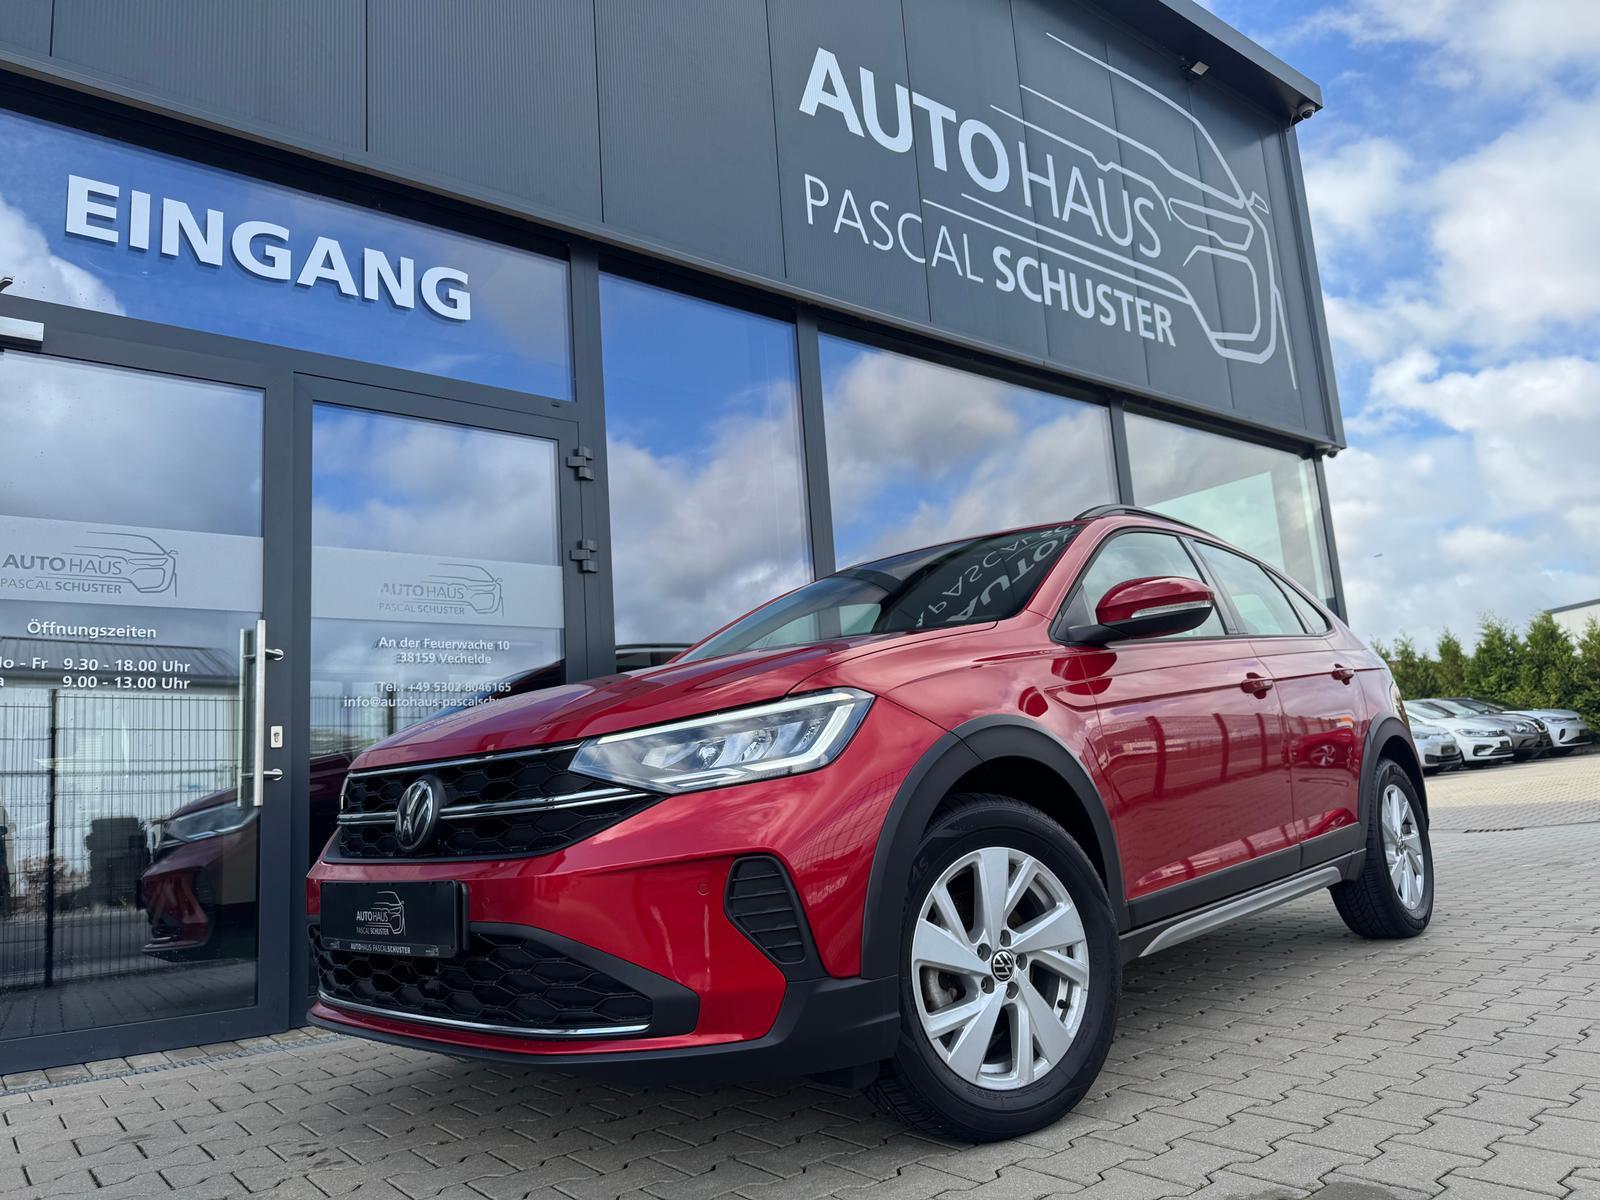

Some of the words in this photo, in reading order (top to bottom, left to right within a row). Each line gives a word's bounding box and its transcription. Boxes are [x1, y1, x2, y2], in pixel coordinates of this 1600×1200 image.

[799, 47, 1162, 258] AUTOHAUS
[65, 174, 471, 322] EINGANG
[804, 174, 984, 283] PASCAL
[992, 246, 1177, 348] SCHUSTER
[2, 553, 122, 576] AUTOHAUS
[0, 577, 51, 591] PASCAL
[55, 581, 122, 594] SCHUSTER
[379, 601, 416, 613] PASCAL
[417, 604, 465, 615] SCHUSTER
[27, 619, 157, 639] Öffnungszeiten
[379, 636, 396, 648] An
[400, 636, 420, 649] der
[424, 638, 494, 650] Feuerwache
[497, 640, 510, 651] 10
[0, 656, 15, 669] o
[31, 657, 49, 670] Fr
[63, 657, 99, 671] 9.30
[115, 659, 157, 672] 18.00
[162, 660, 191, 673] Uhr
[400, 651, 436, 663] 38159
[439, 652, 492, 664] Vechelde
[62, 675, 98, 688] 9.00
[114, 676, 157, 689] 13.00
[161, 677, 190, 690] Uhr
[407, 681, 430, 692] +49
[433, 682, 462, 692] 5302
[465, 682, 512, 693] 8046165
[343, 695, 500, 709] info@autohaus-pascalsch
[356, 911, 389, 922] AUTOHAUS
[370, 927, 390, 935] SCHUSTER
